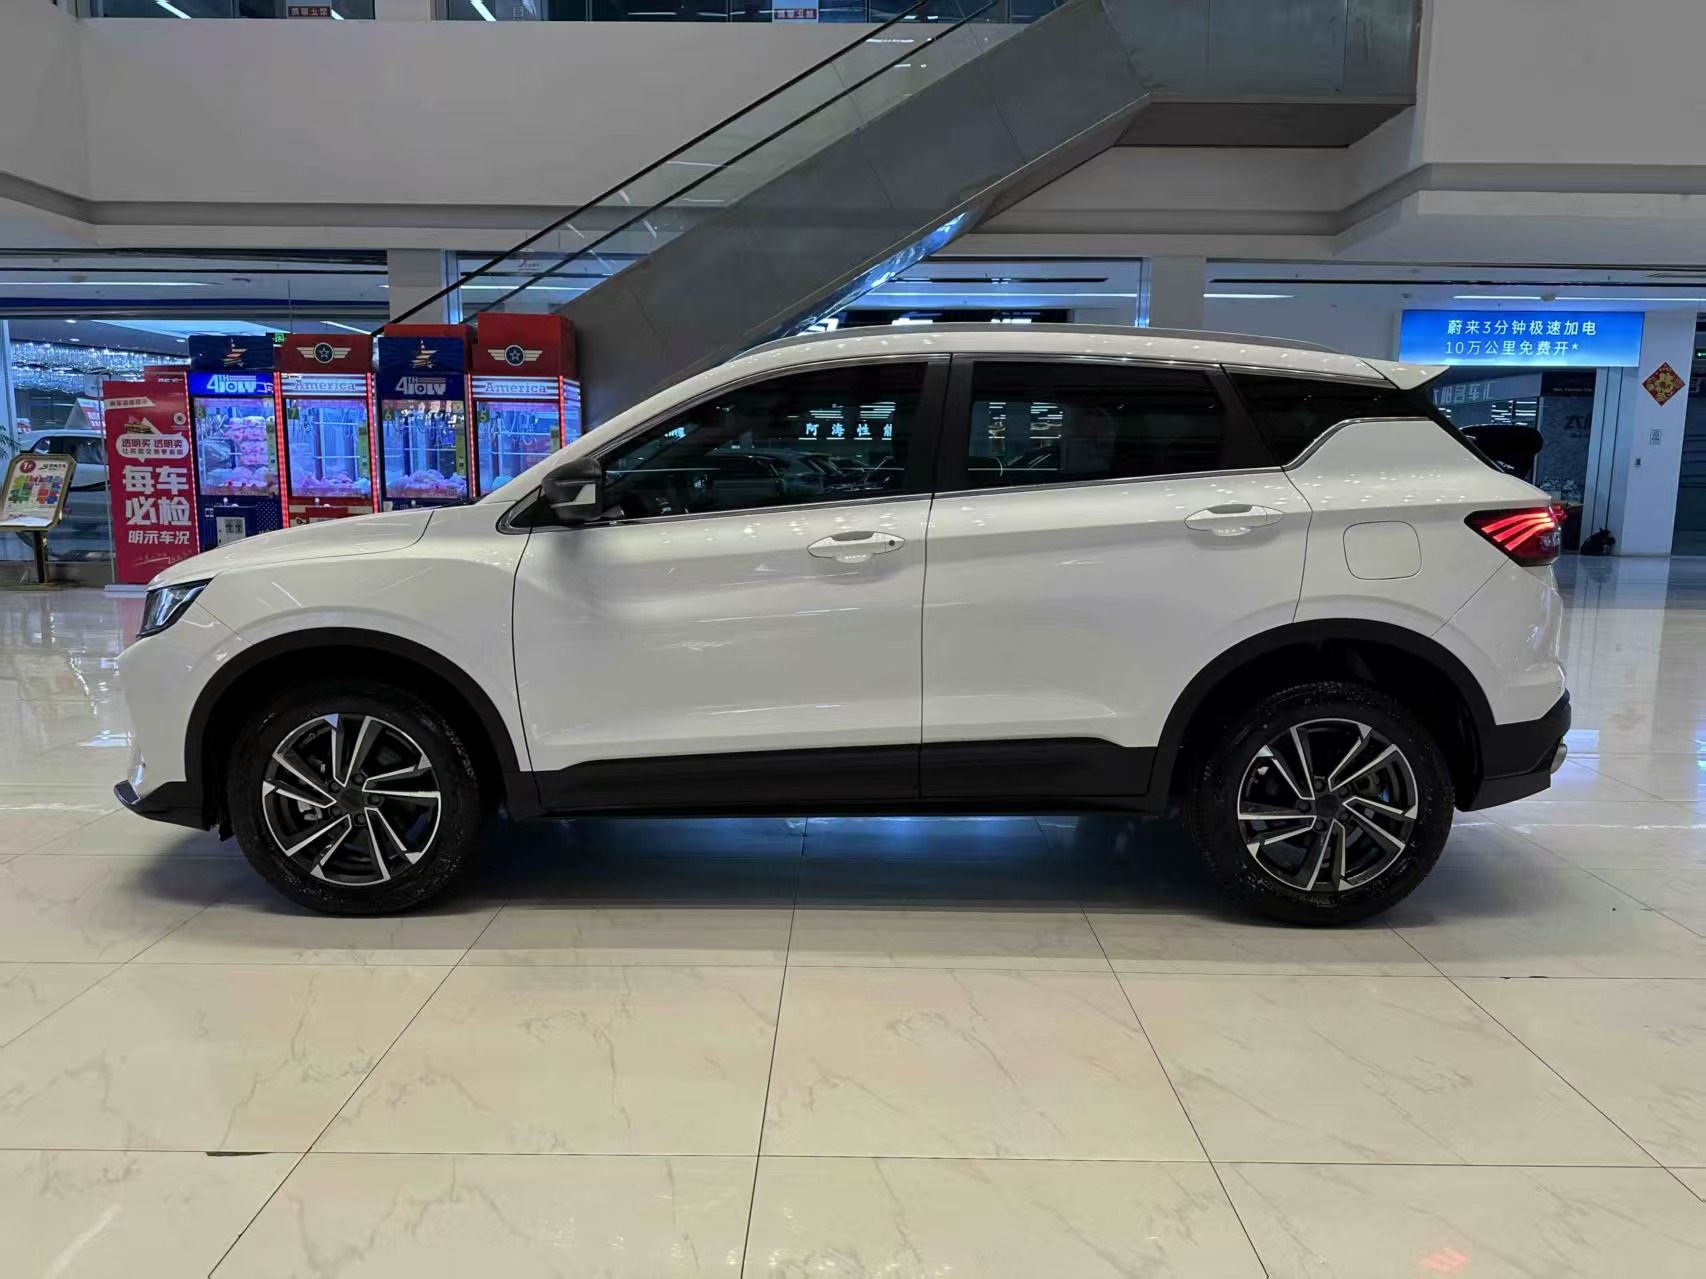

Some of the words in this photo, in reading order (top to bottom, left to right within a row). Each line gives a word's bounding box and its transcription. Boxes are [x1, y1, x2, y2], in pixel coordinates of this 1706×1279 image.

[1447, 320, 1597, 336] 蔚来3分钟极速加电
[294, 380, 356, 392] America
[485, 382, 547, 393] America
[122, 465, 189, 495] 每车
[125, 496, 192, 526] 必检
[128, 530, 190, 545] 明示车况
